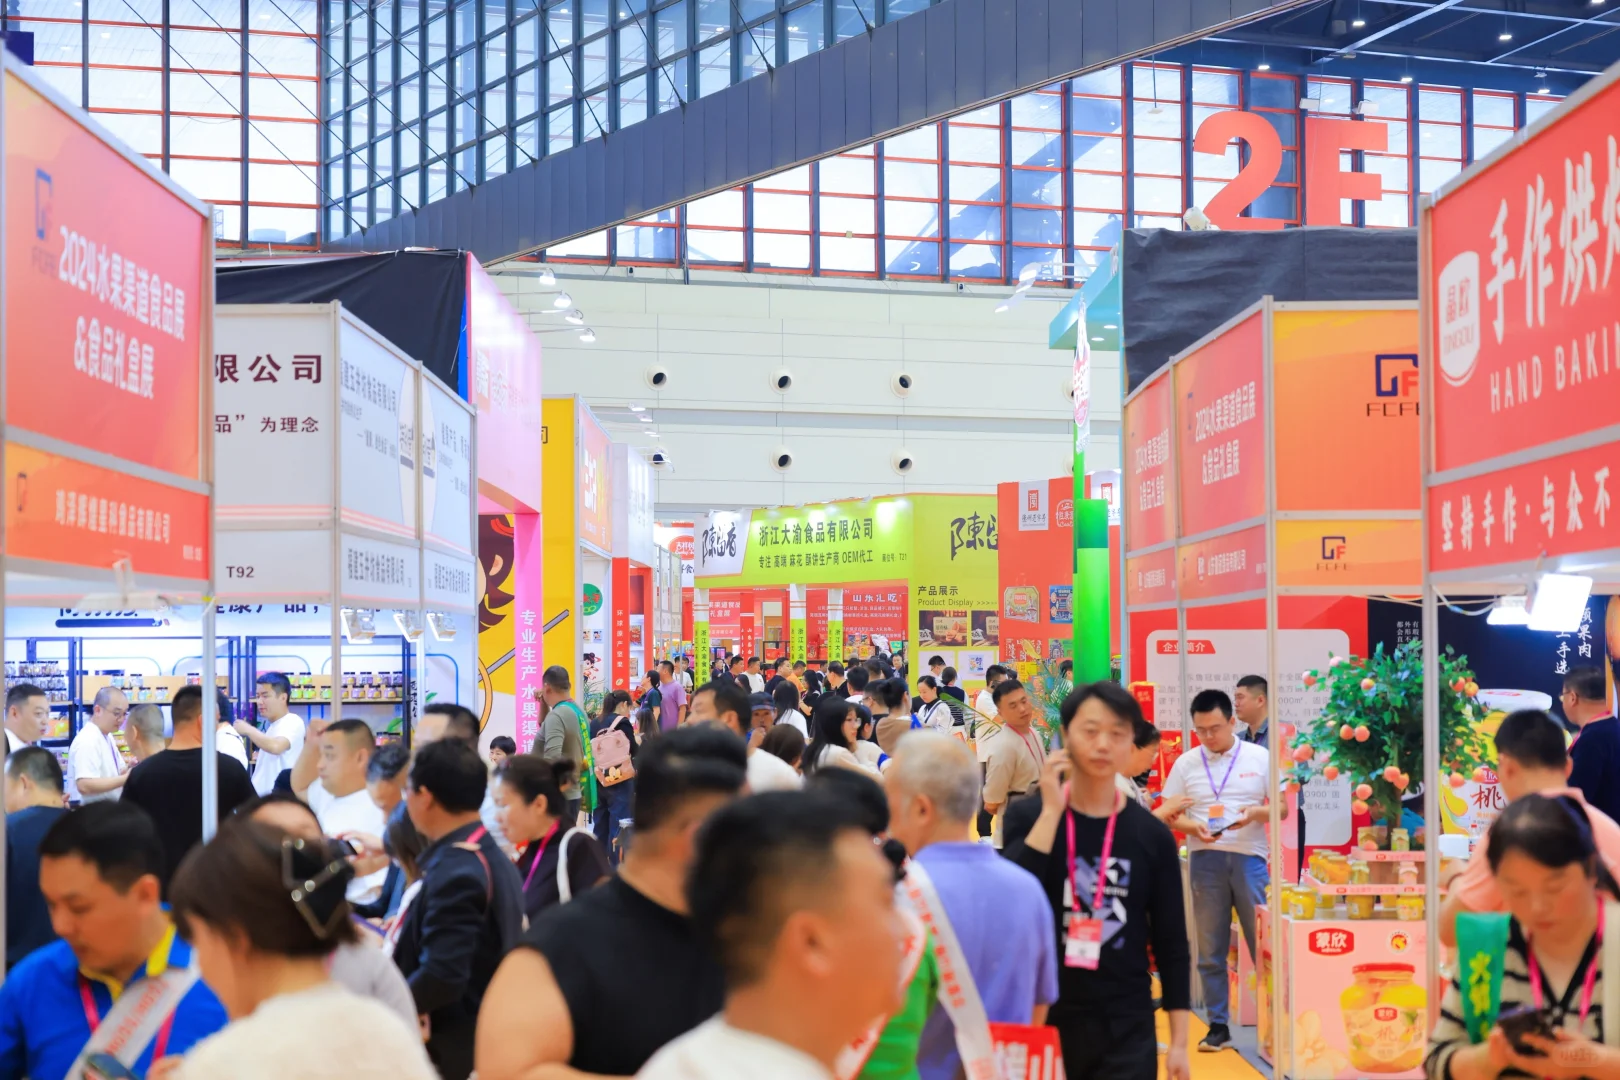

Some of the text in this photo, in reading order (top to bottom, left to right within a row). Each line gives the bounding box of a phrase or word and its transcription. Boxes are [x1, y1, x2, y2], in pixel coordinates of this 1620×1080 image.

[1194, 111, 1388, 230] 2F
[1490, 355, 1543, 413] HAND
[226, 566, 255, 578] T92
[917, 586, 959, 596] 产品展示
[917, 598, 974, 608] Product Display
